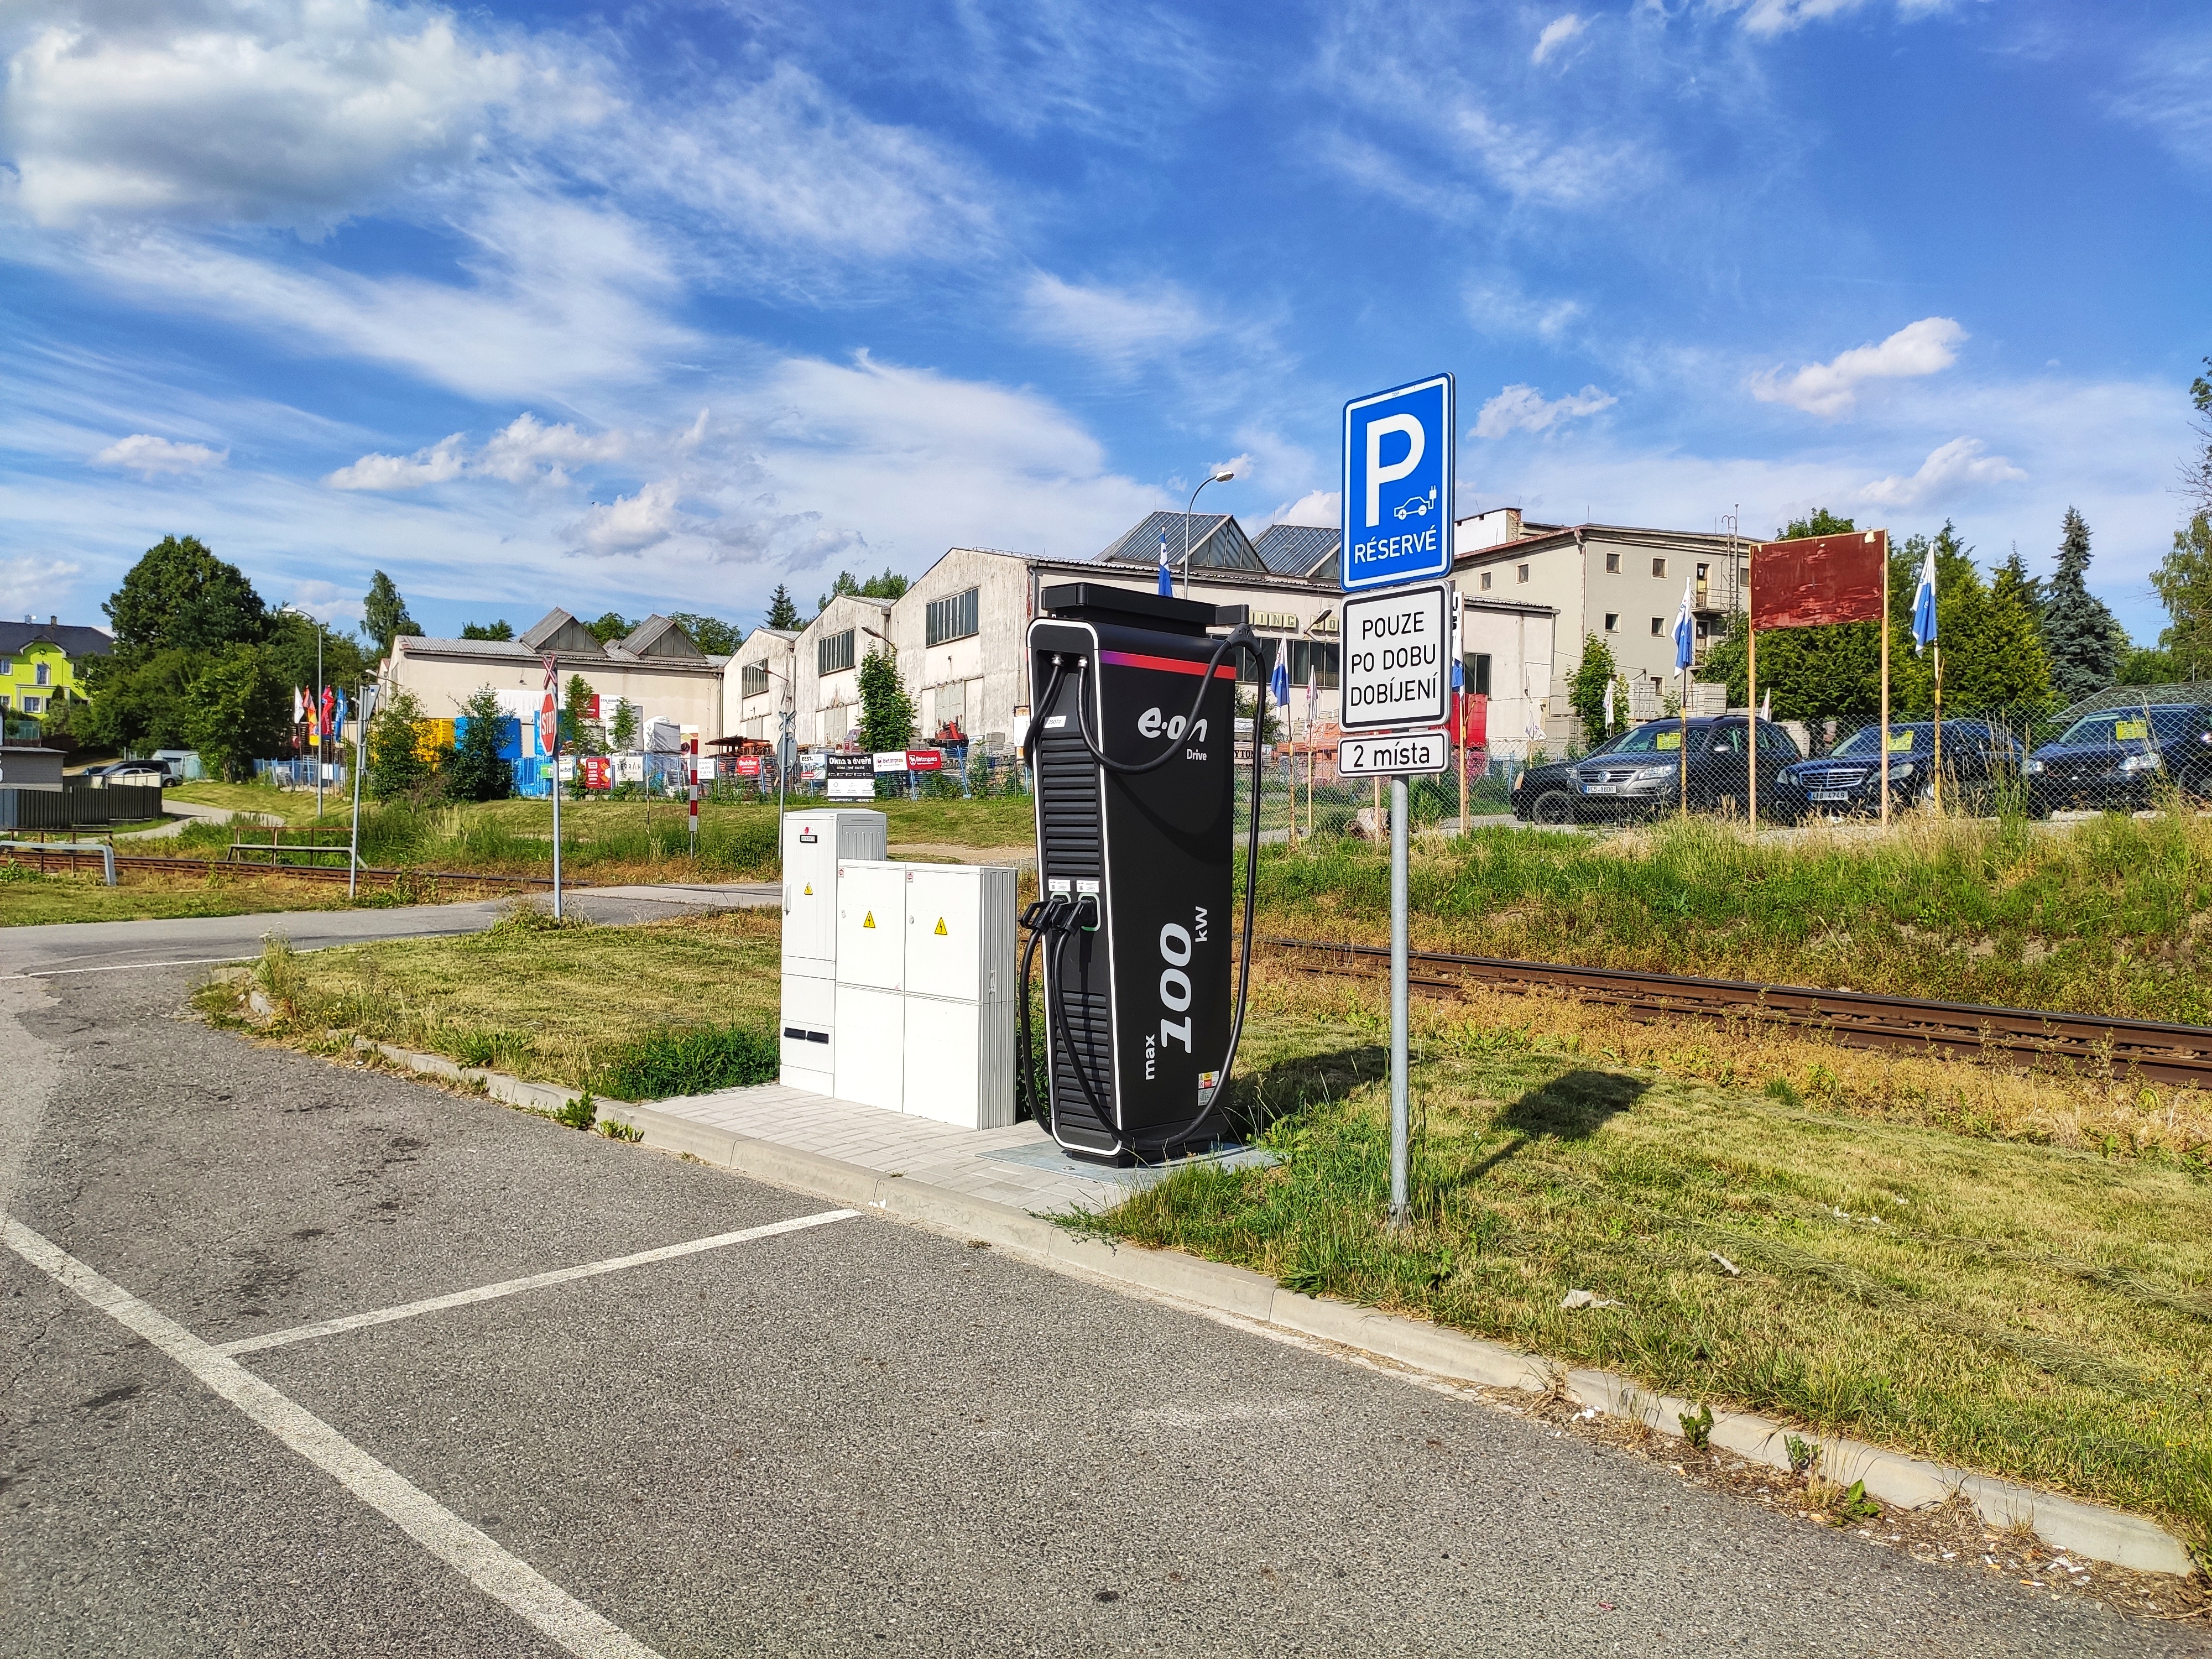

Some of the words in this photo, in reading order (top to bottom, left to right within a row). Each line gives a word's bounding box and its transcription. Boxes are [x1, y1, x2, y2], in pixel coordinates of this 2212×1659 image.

[1365, 413, 1425, 528] P
[1354, 524, 1437, 564] RÉSERVÉ
[1363, 611, 1425, 640] POUZE
[1351, 652, 1375, 674] PO
[1383, 643, 1436, 671] DOBU
[1350, 671, 1438, 707] DOBÍJENÍ
[541, 710, 555, 736] STOP
[829, 757, 847, 765] Okna
[852, 756, 872, 765] dveře
[1186, 748, 1208, 761] Drive
[1353, 744, 1364, 768] 2
[1374, 741, 1430, 766] místa
[1195, 906, 1208, 942] kW
[1159, 923, 1192, 1054] 100
[1145, 1034, 1155, 1081] max
